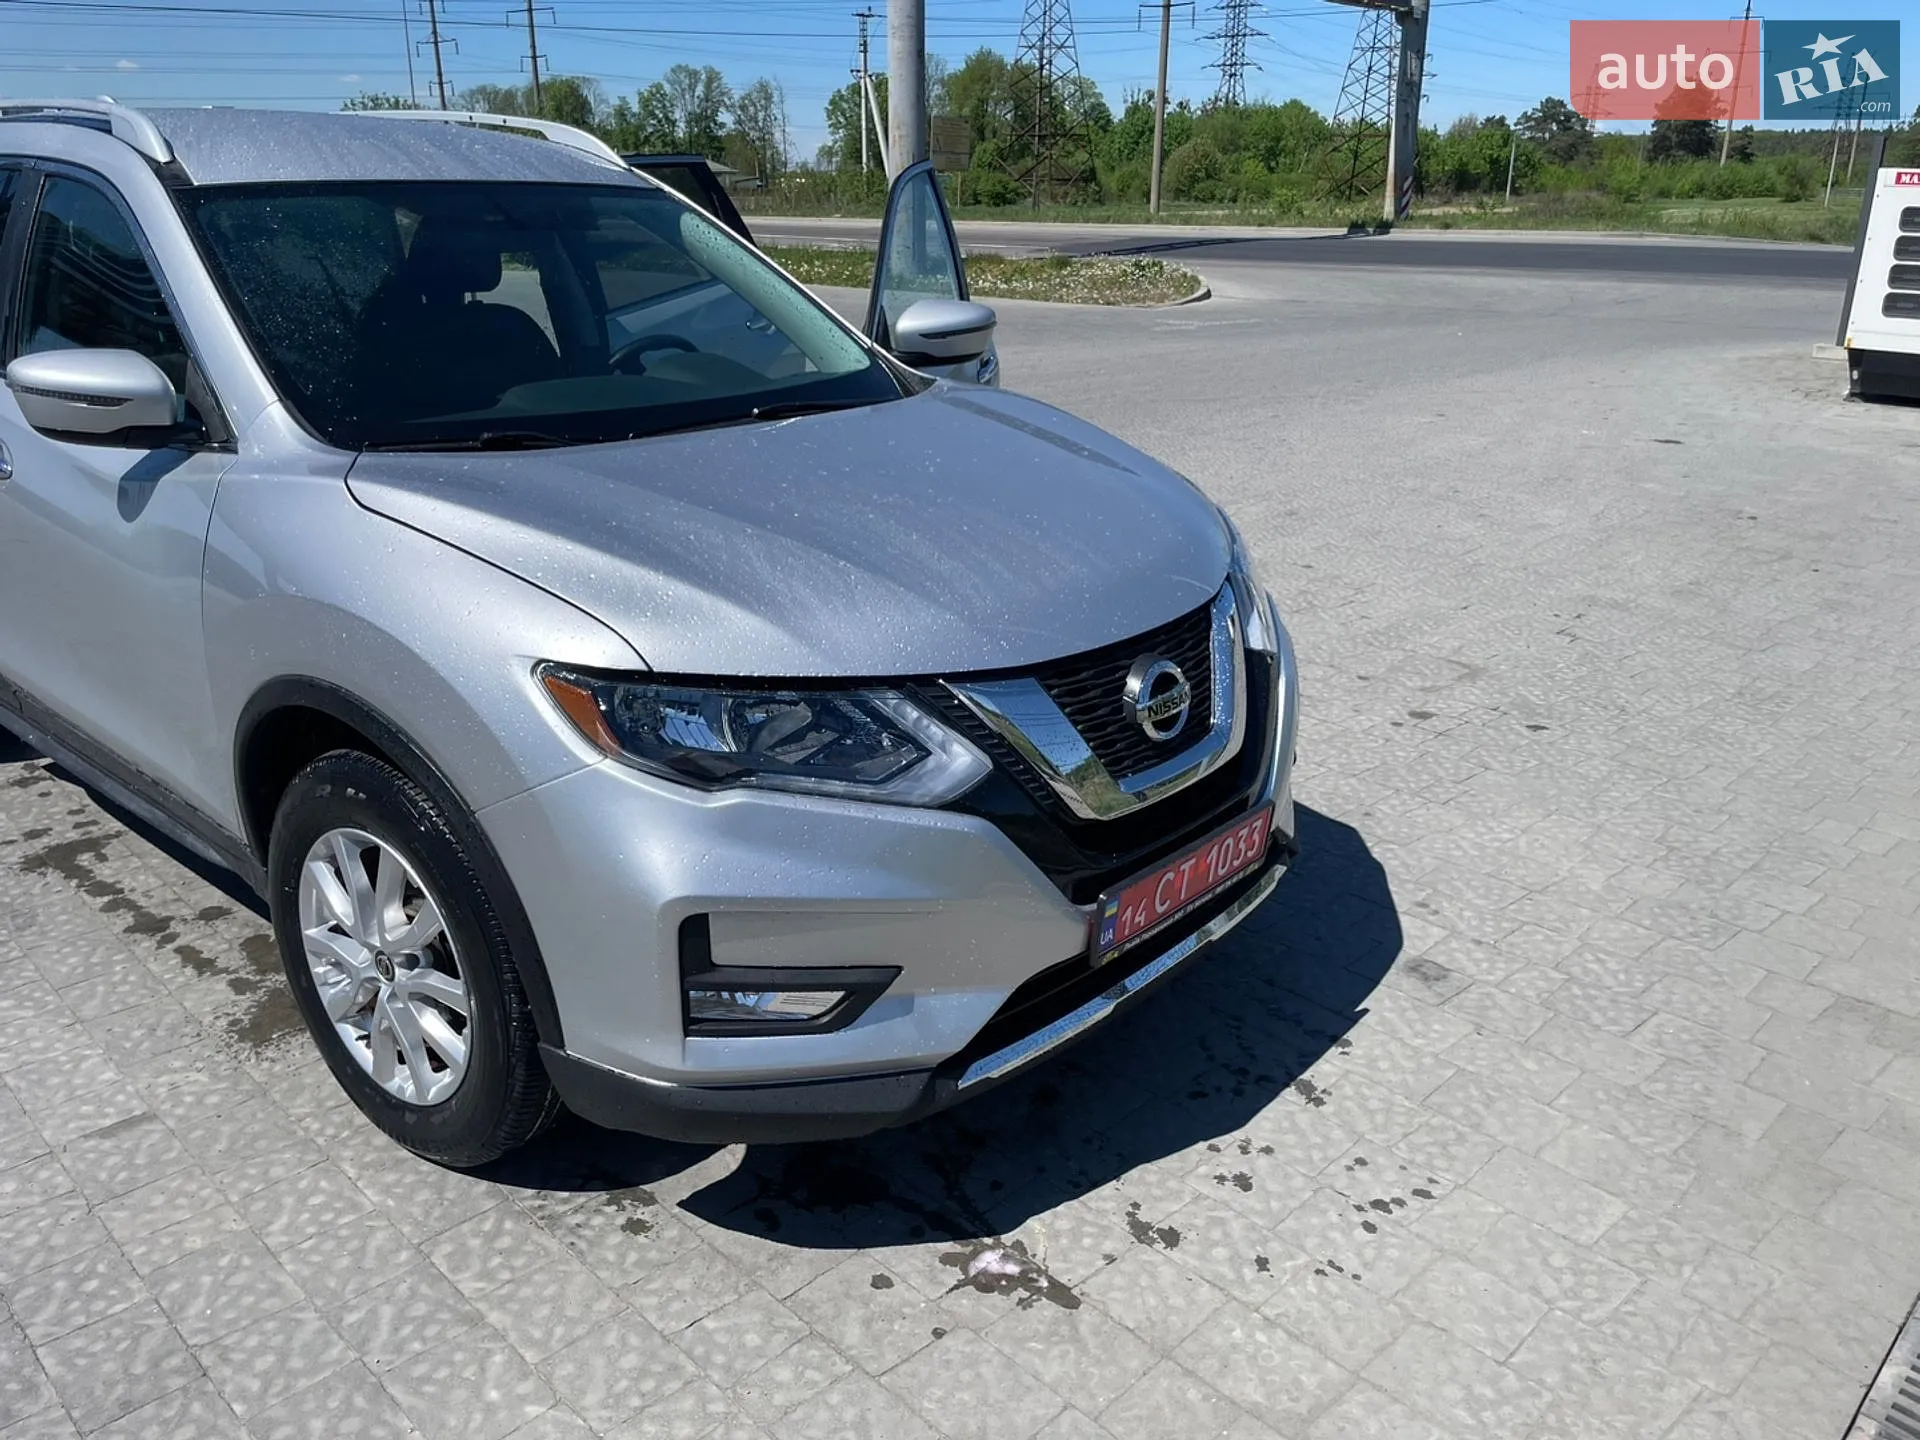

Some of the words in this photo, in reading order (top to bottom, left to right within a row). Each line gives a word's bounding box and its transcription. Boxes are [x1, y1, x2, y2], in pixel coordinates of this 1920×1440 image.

[1121, 898, 1147, 936] 14
[1207, 818, 1263, 883] 1033
[1100, 928, 1113, 945] UA
